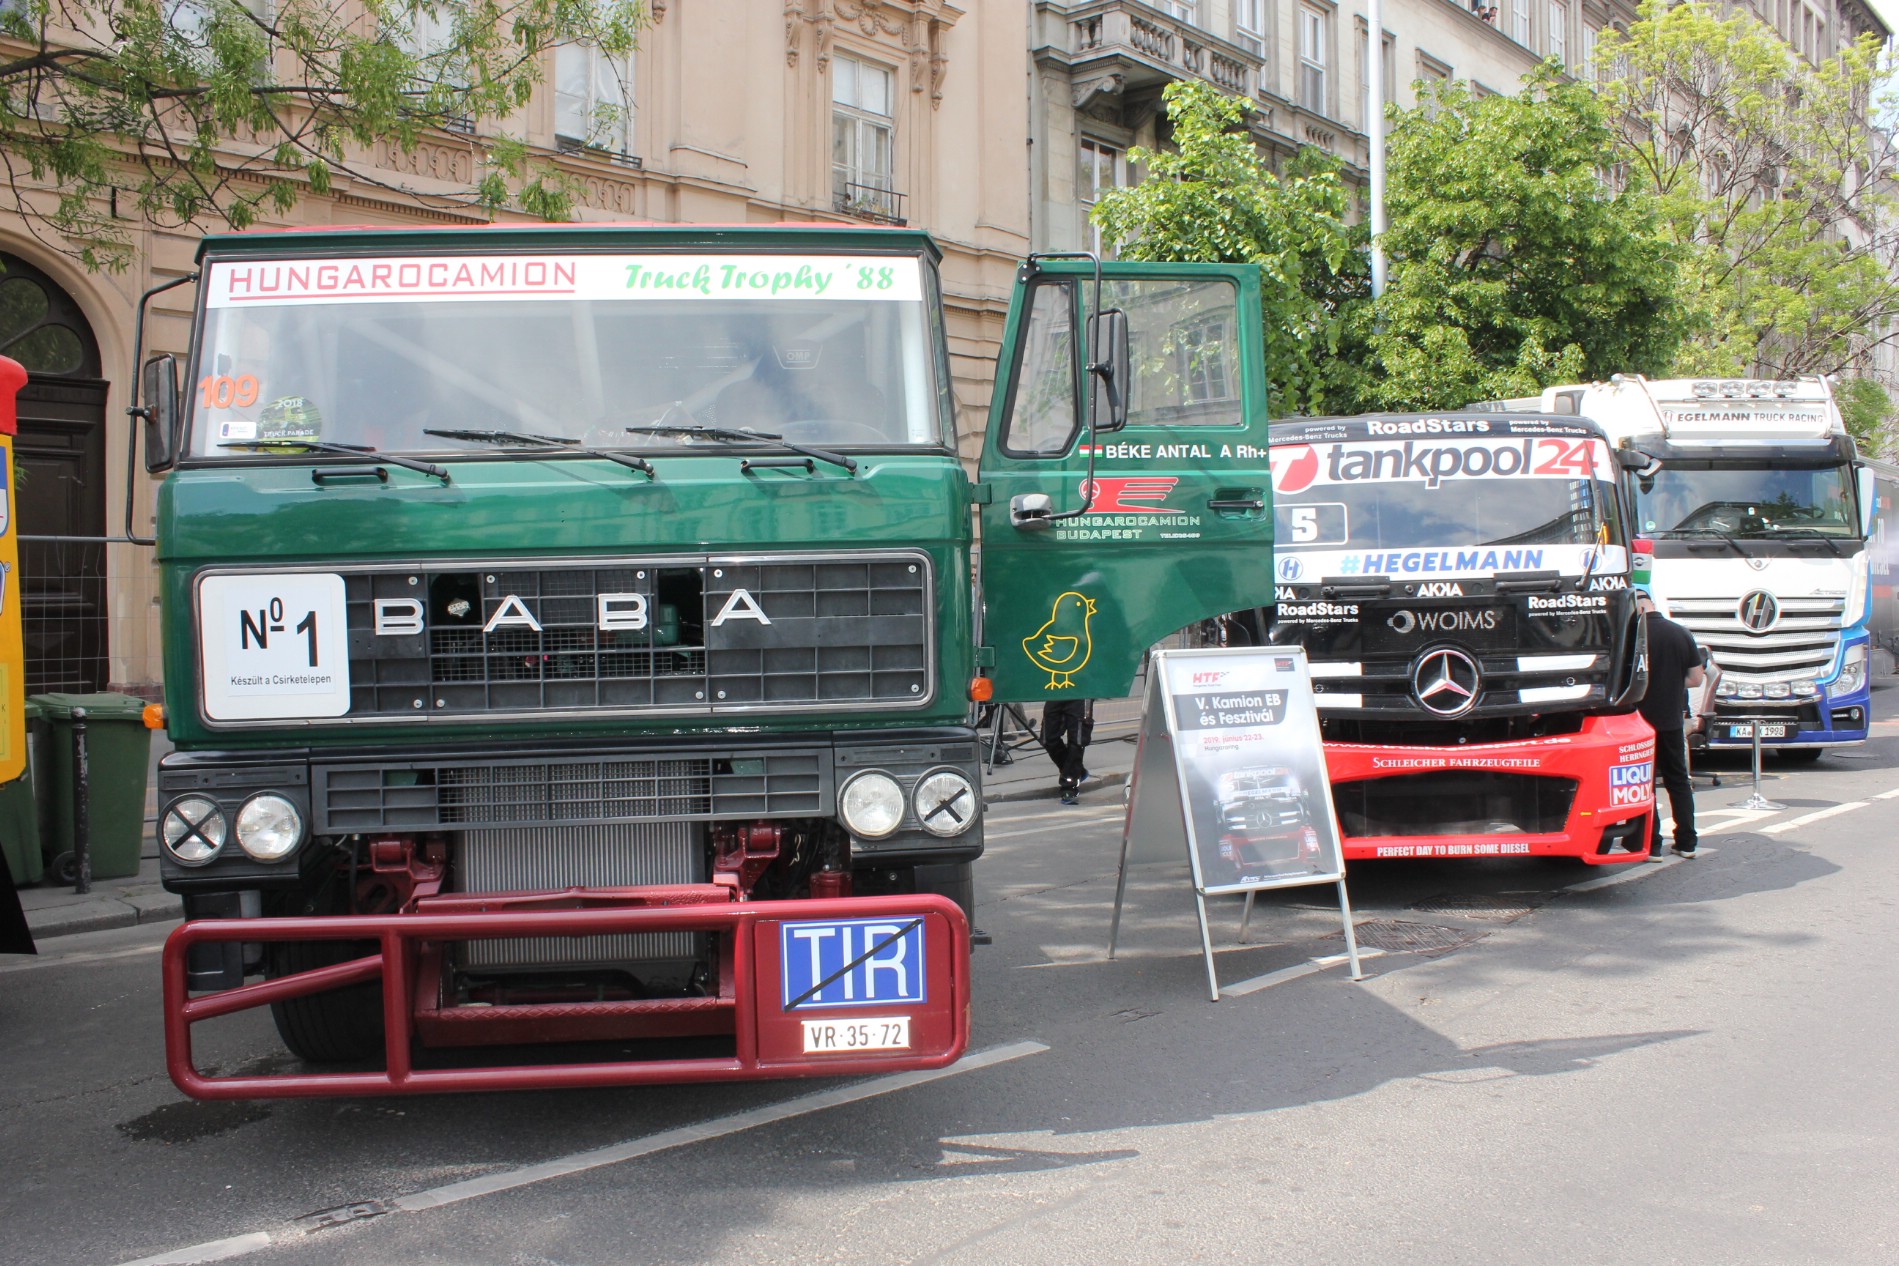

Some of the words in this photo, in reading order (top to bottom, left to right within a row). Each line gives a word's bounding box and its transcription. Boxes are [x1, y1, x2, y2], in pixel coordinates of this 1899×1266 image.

[229, 261, 576, 293] HUNGAROCAMION
[625, 264, 711, 295] Truck
[720, 264, 833, 295] Trophy
[198, 375, 259, 409] 109
[275, 398, 304, 410] 2018
[1754, 412, 1785, 422] TRUCK
[1788, 413, 1823, 423] RACING
[264, 429, 286, 438] TRUCK
[287, 429, 314, 437] PARADE
[1305, 425, 1336, 433] powered
[1367, 419, 1490, 435] RoadStars
[1268, 433, 1322, 443] Mercedes-Benz
[1105, 442, 1151, 459] BÉKE
[1156, 445, 1211, 458] ANTAL
[1220, 445, 1232, 458] A
[1237, 445, 1267, 458] Rh+
[1327, 435, 1599, 487] tankpool24
[1056, 516, 1200, 528] HUNGAROCAMION
[1292, 507, 1318, 542] 5
[1056, 529, 1143, 540] BUDAPEST
[1340, 550, 1543, 574] #HEGELMANN
[1277, 602, 1359, 616] RoadStars
[1528, 594, 1607, 609] RoadStars
[1417, 610, 1496, 631] WOIMS
[296, 610, 318, 667] 1
[230, 675, 263, 686] Készült
[272, 674, 332, 685] Csirketelepen
[1193, 671, 1221, 684] HTF
[1195, 697, 1210, 710] V.
[1212, 694, 1263, 710] Kamion
[1265, 693, 1281, 706] EB
[1200, 712, 1216, 726] és
[1218, 708, 1274, 725] Fesztivál
[1736, 727, 1747, 736] KA
[1764, 727, 1784, 736] 1998
[1203, 736, 1221, 744] 2019.
[1373, 757, 1446, 768] SCHLEICHER
[1450, 758, 1541, 767] FAHRZEUGTEILE
[1612, 764, 1652, 786] LIQUI
[1613, 783, 1651, 805] MOLY
[1377, 846, 1415, 857] PERFECT
[1416, 845, 1433, 856] DAY
[1434, 845, 1446, 855] TO
[1447, 844, 1473, 855] BURN
[1474, 843, 1499, 854] SOME
[1500, 843, 1530, 854] DIESEL
[793, 924, 909, 1001] TIR
